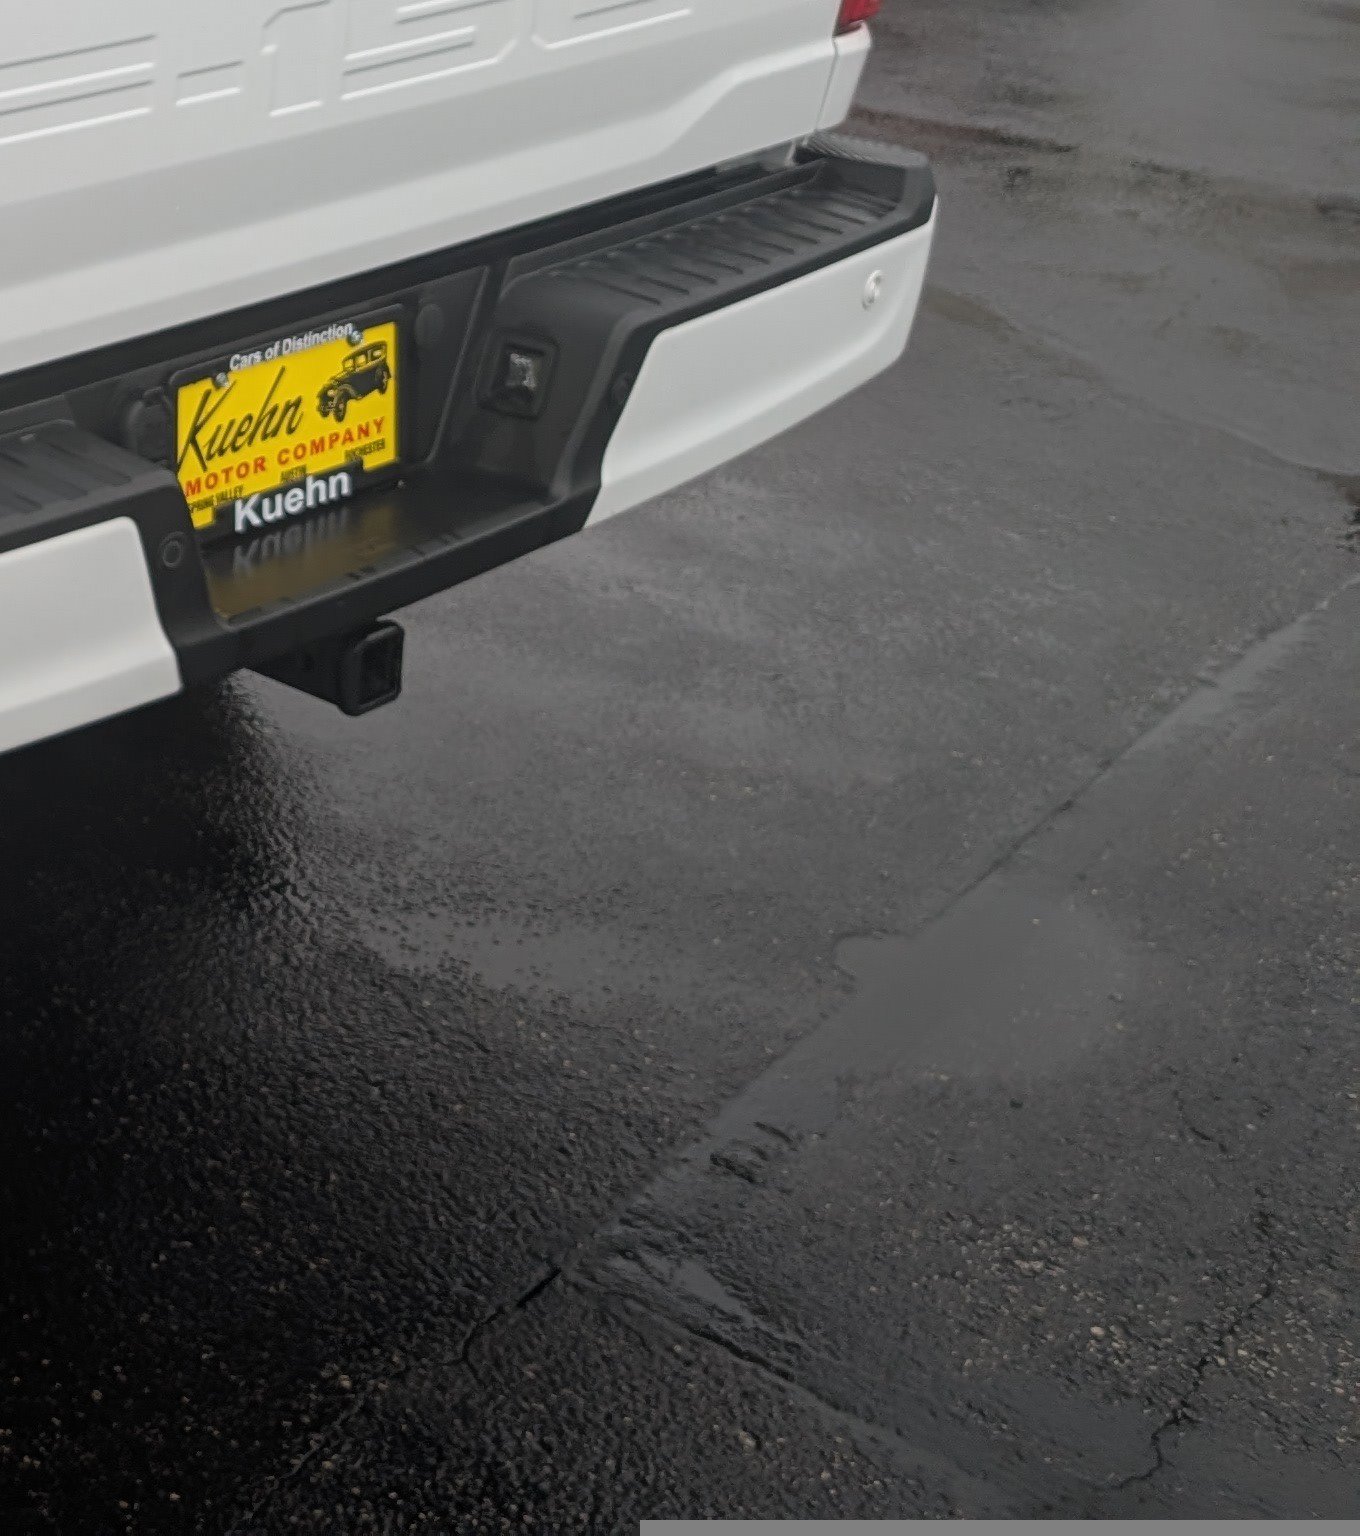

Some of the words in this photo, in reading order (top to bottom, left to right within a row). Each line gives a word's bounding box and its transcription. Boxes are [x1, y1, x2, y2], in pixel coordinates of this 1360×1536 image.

[230, 348, 261, 371] Cars
[265, 342, 279, 361] of
[282, 321, 354, 356] Distinction
[177, 365, 304, 472] Kuehn
[183, 455, 267, 498] MOTOR
[276, 416, 386, 466] COMPANY
[233, 470, 353, 534] Kuehn
